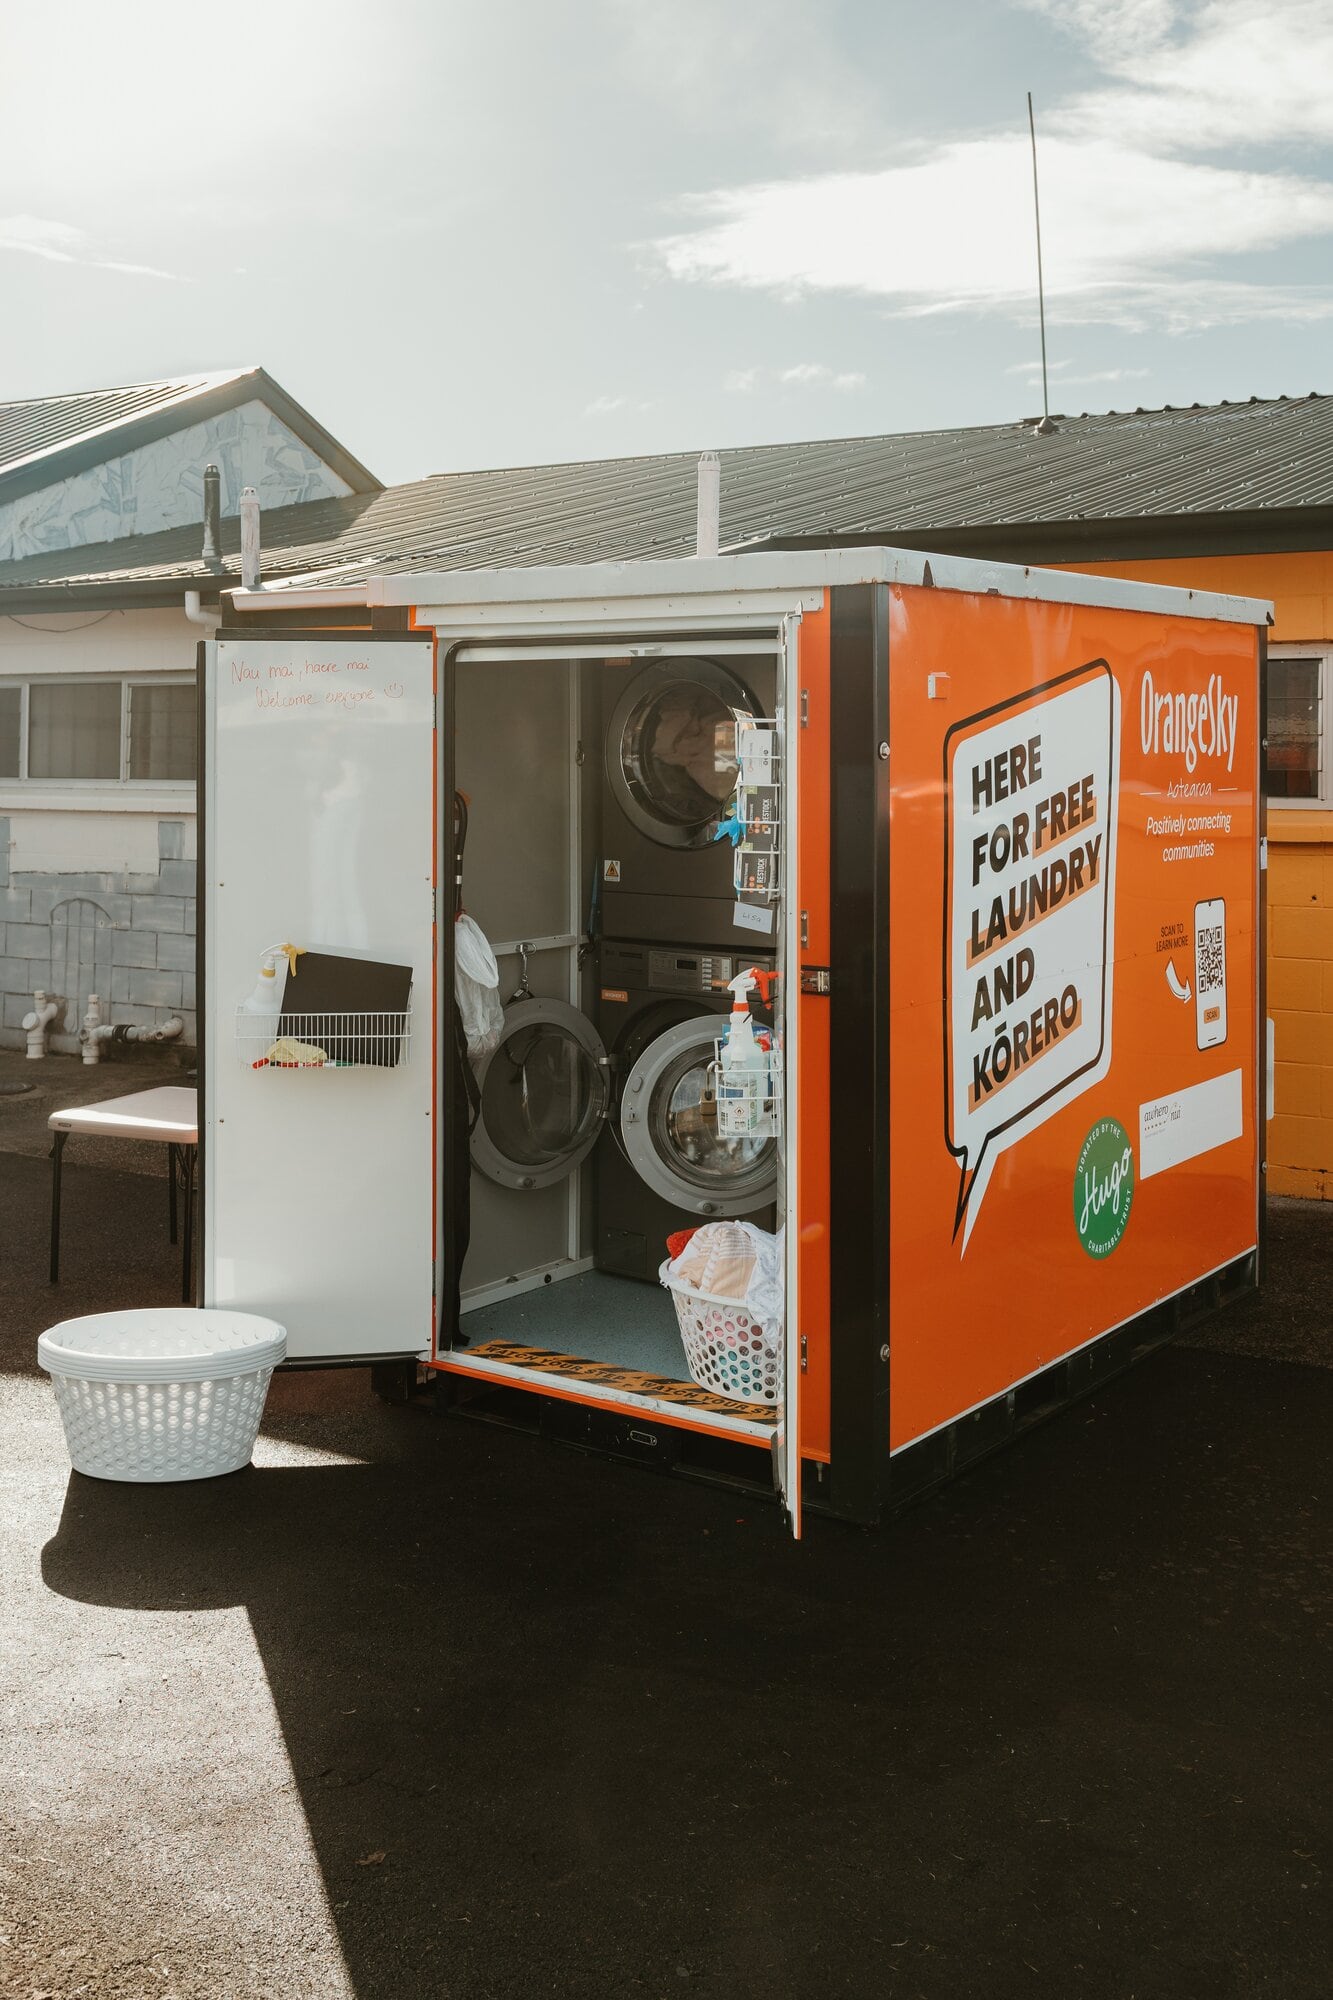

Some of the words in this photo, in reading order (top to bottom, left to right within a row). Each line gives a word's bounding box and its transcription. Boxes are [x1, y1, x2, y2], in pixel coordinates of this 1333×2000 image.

[232, 661, 259, 684] Nau
[347, 657, 370, 671] mai
[255, 687, 319, 708] Welcome
[325, 689, 376, 710] everyone
[972, 734, 1042, 815] HERE
[1166, 778, 1212, 798] Aotearoa
[762, 798, 770, 824] ESTOCK
[1146, 813, 1186, 837] Positively
[1187, 810, 1232, 834] connecting
[972, 812, 1030, 887] FOR
[1035, 773, 1094, 850] FREE
[1162, 840, 1215, 863] communities
[972, 832, 1103, 959] LAUNDRY
[1156, 939, 1173, 953] LEARN
[1172, 934, 1188, 949] MORE
[1160, 925, 1176, 938] SCAN
[1176, 922, 1184, 934] TO
[971, 947, 1035, 1033] AND
[1206, 1010, 1218, 1021] SCAN
[973, 984, 1078, 1103] KŌRERO
[1078, 1127, 1100, 1174] DONATED
[1101, 1122, 1110, 1133] BY
[1110, 1123, 1121, 1139] THE
[1079, 1146, 1132, 1235] Hugo
[1088, 1226, 1121, 1254] CHARITABLE
[1120, 1189, 1132, 1226] TRUST
[485, 1346, 538, 1361] WATCH
[540, 1356, 583, 1371] YOUR
[584, 1368, 627, 1380] STEP
[640, 1381, 697, 1399] WATCH
[702, 1395, 748, 1411] YOUR
[751, 1407, 778, 1418] ST
